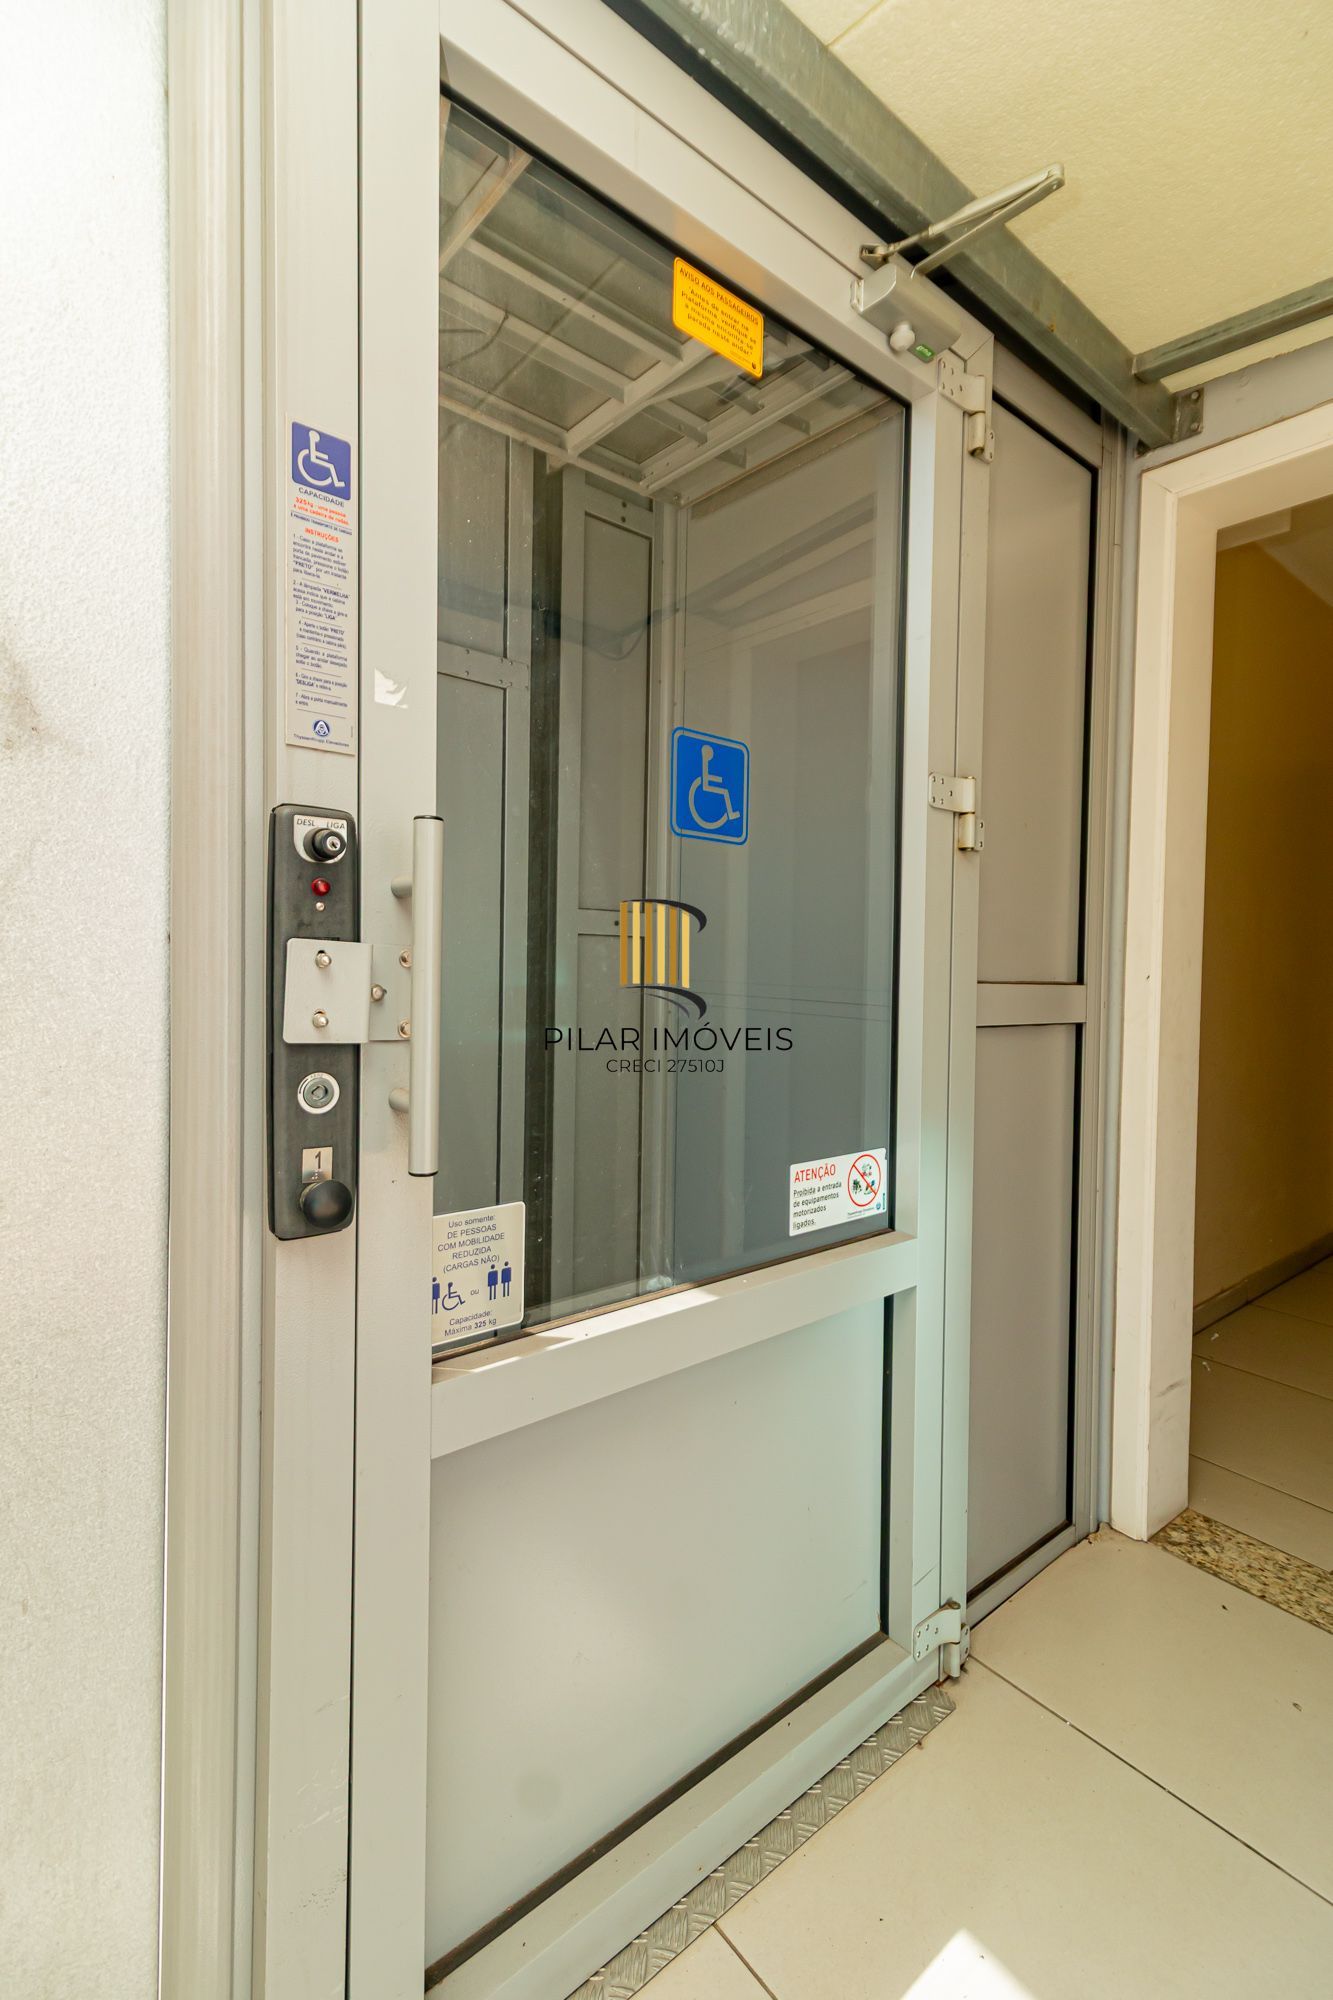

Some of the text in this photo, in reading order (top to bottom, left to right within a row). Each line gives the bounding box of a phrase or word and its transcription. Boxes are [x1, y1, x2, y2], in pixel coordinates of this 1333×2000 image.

[297, 818, 346, 829] DESL LIGA
[794, 1163, 836, 1184] ATENÇÃO
[794, 1187, 815, 1197] Proibida
[822, 1182, 842, 1190] entrada
[802, 1193, 839, 1206] equipamentos
[793, 1205, 826, 1217] motorizados
[449, 1215, 495, 1228] Uso somente:
[793, 1219, 816, 1230] ligados.
[448, 1224, 496, 1239] DE PESSOAS
[438, 1233, 504, 1252] COM MOBILIDADE
[453, 1246, 491, 1259] REDUZIDA
[443, 1254, 500, 1273] (CARGAS NÃO)
[450, 1310, 492, 1326] Capacidade:
[445, 1317, 496, 1336] Máxima 325 kg
